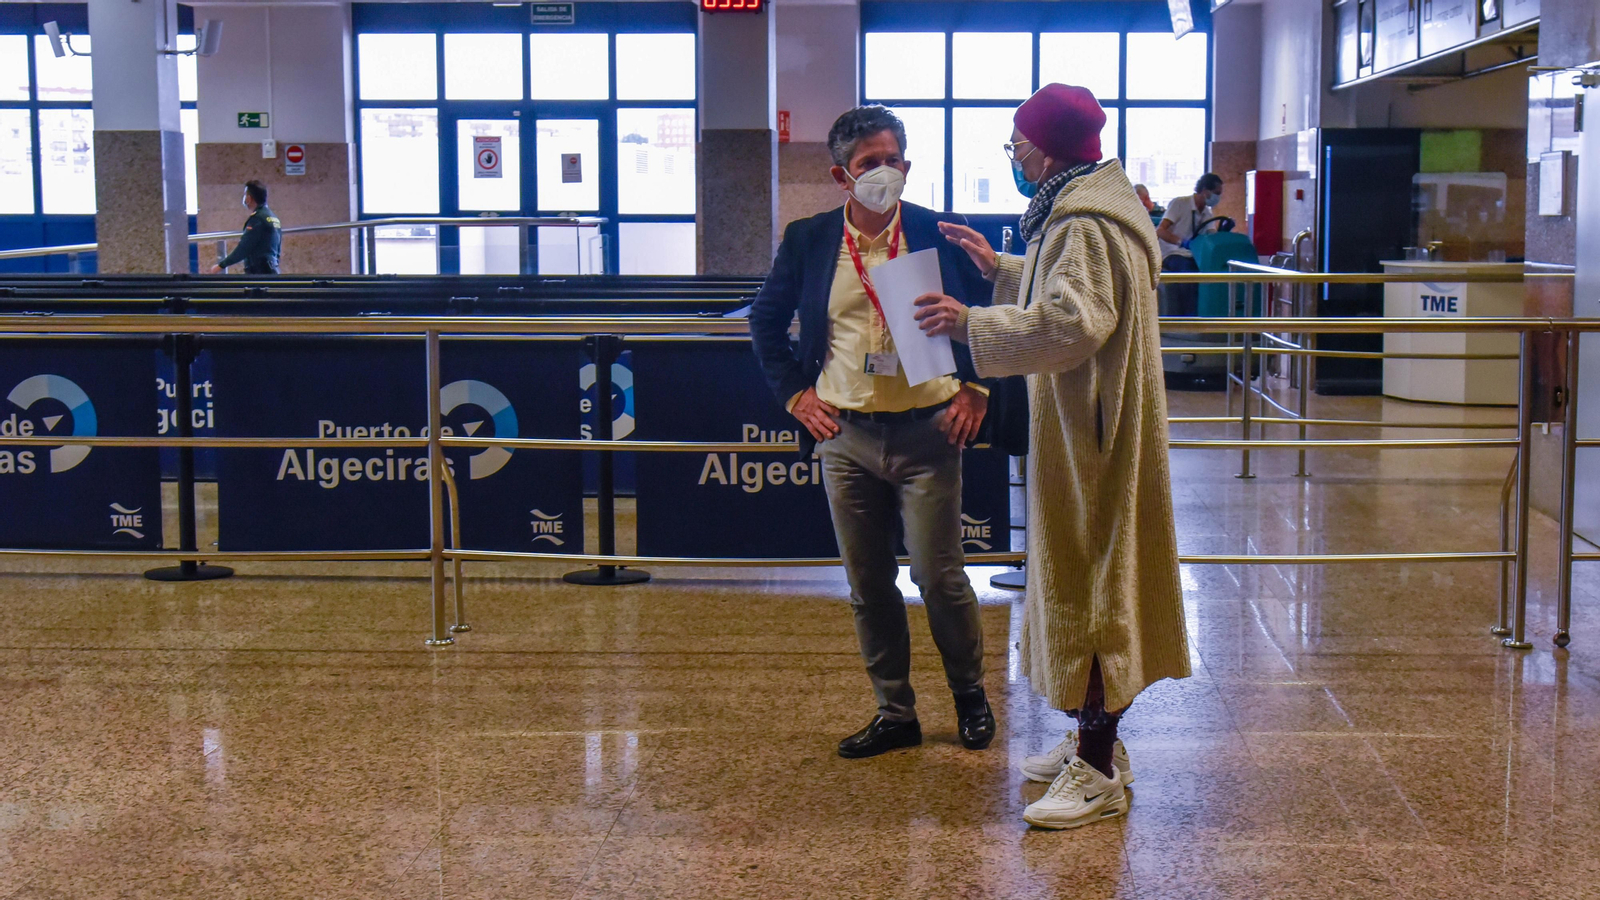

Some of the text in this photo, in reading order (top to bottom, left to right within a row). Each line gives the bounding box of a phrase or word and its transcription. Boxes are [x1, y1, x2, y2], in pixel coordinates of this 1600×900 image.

[1420, 294, 1458, 313] TME
[318, 419, 411, 438] Puerto
[110, 514, 143, 527] TME
[530, 521, 563, 534] TME
[961, 525, 991, 538] TME
